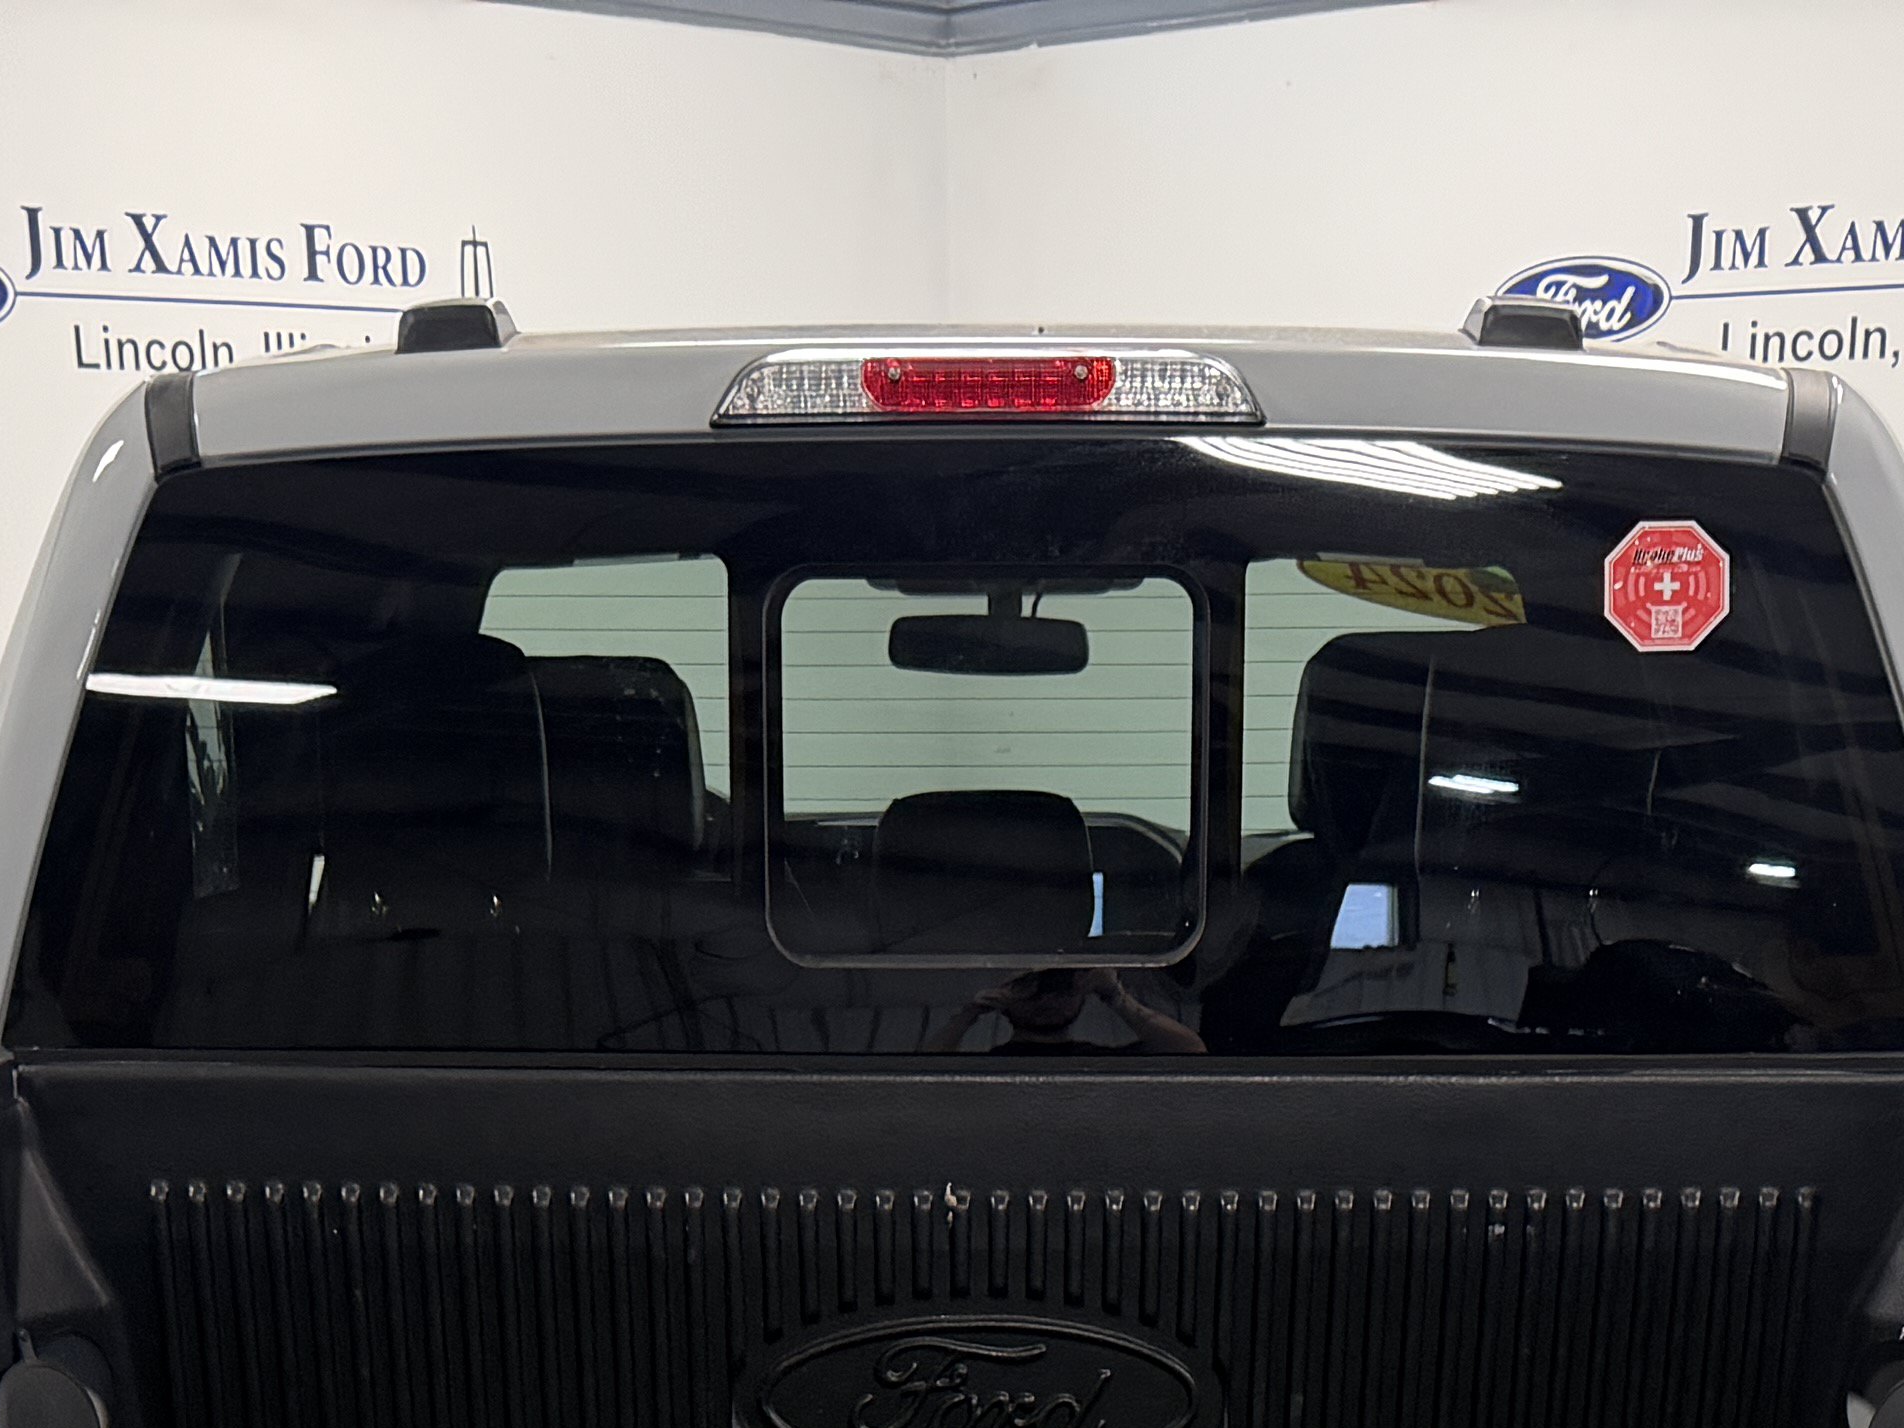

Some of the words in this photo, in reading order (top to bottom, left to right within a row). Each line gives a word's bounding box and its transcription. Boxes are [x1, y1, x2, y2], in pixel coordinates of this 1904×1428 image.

[19, 205, 111, 280] JIM
[124, 212, 286, 281] XAMIS
[300, 223, 427, 288] FORD
[1681, 212, 1770, 285] JIM
